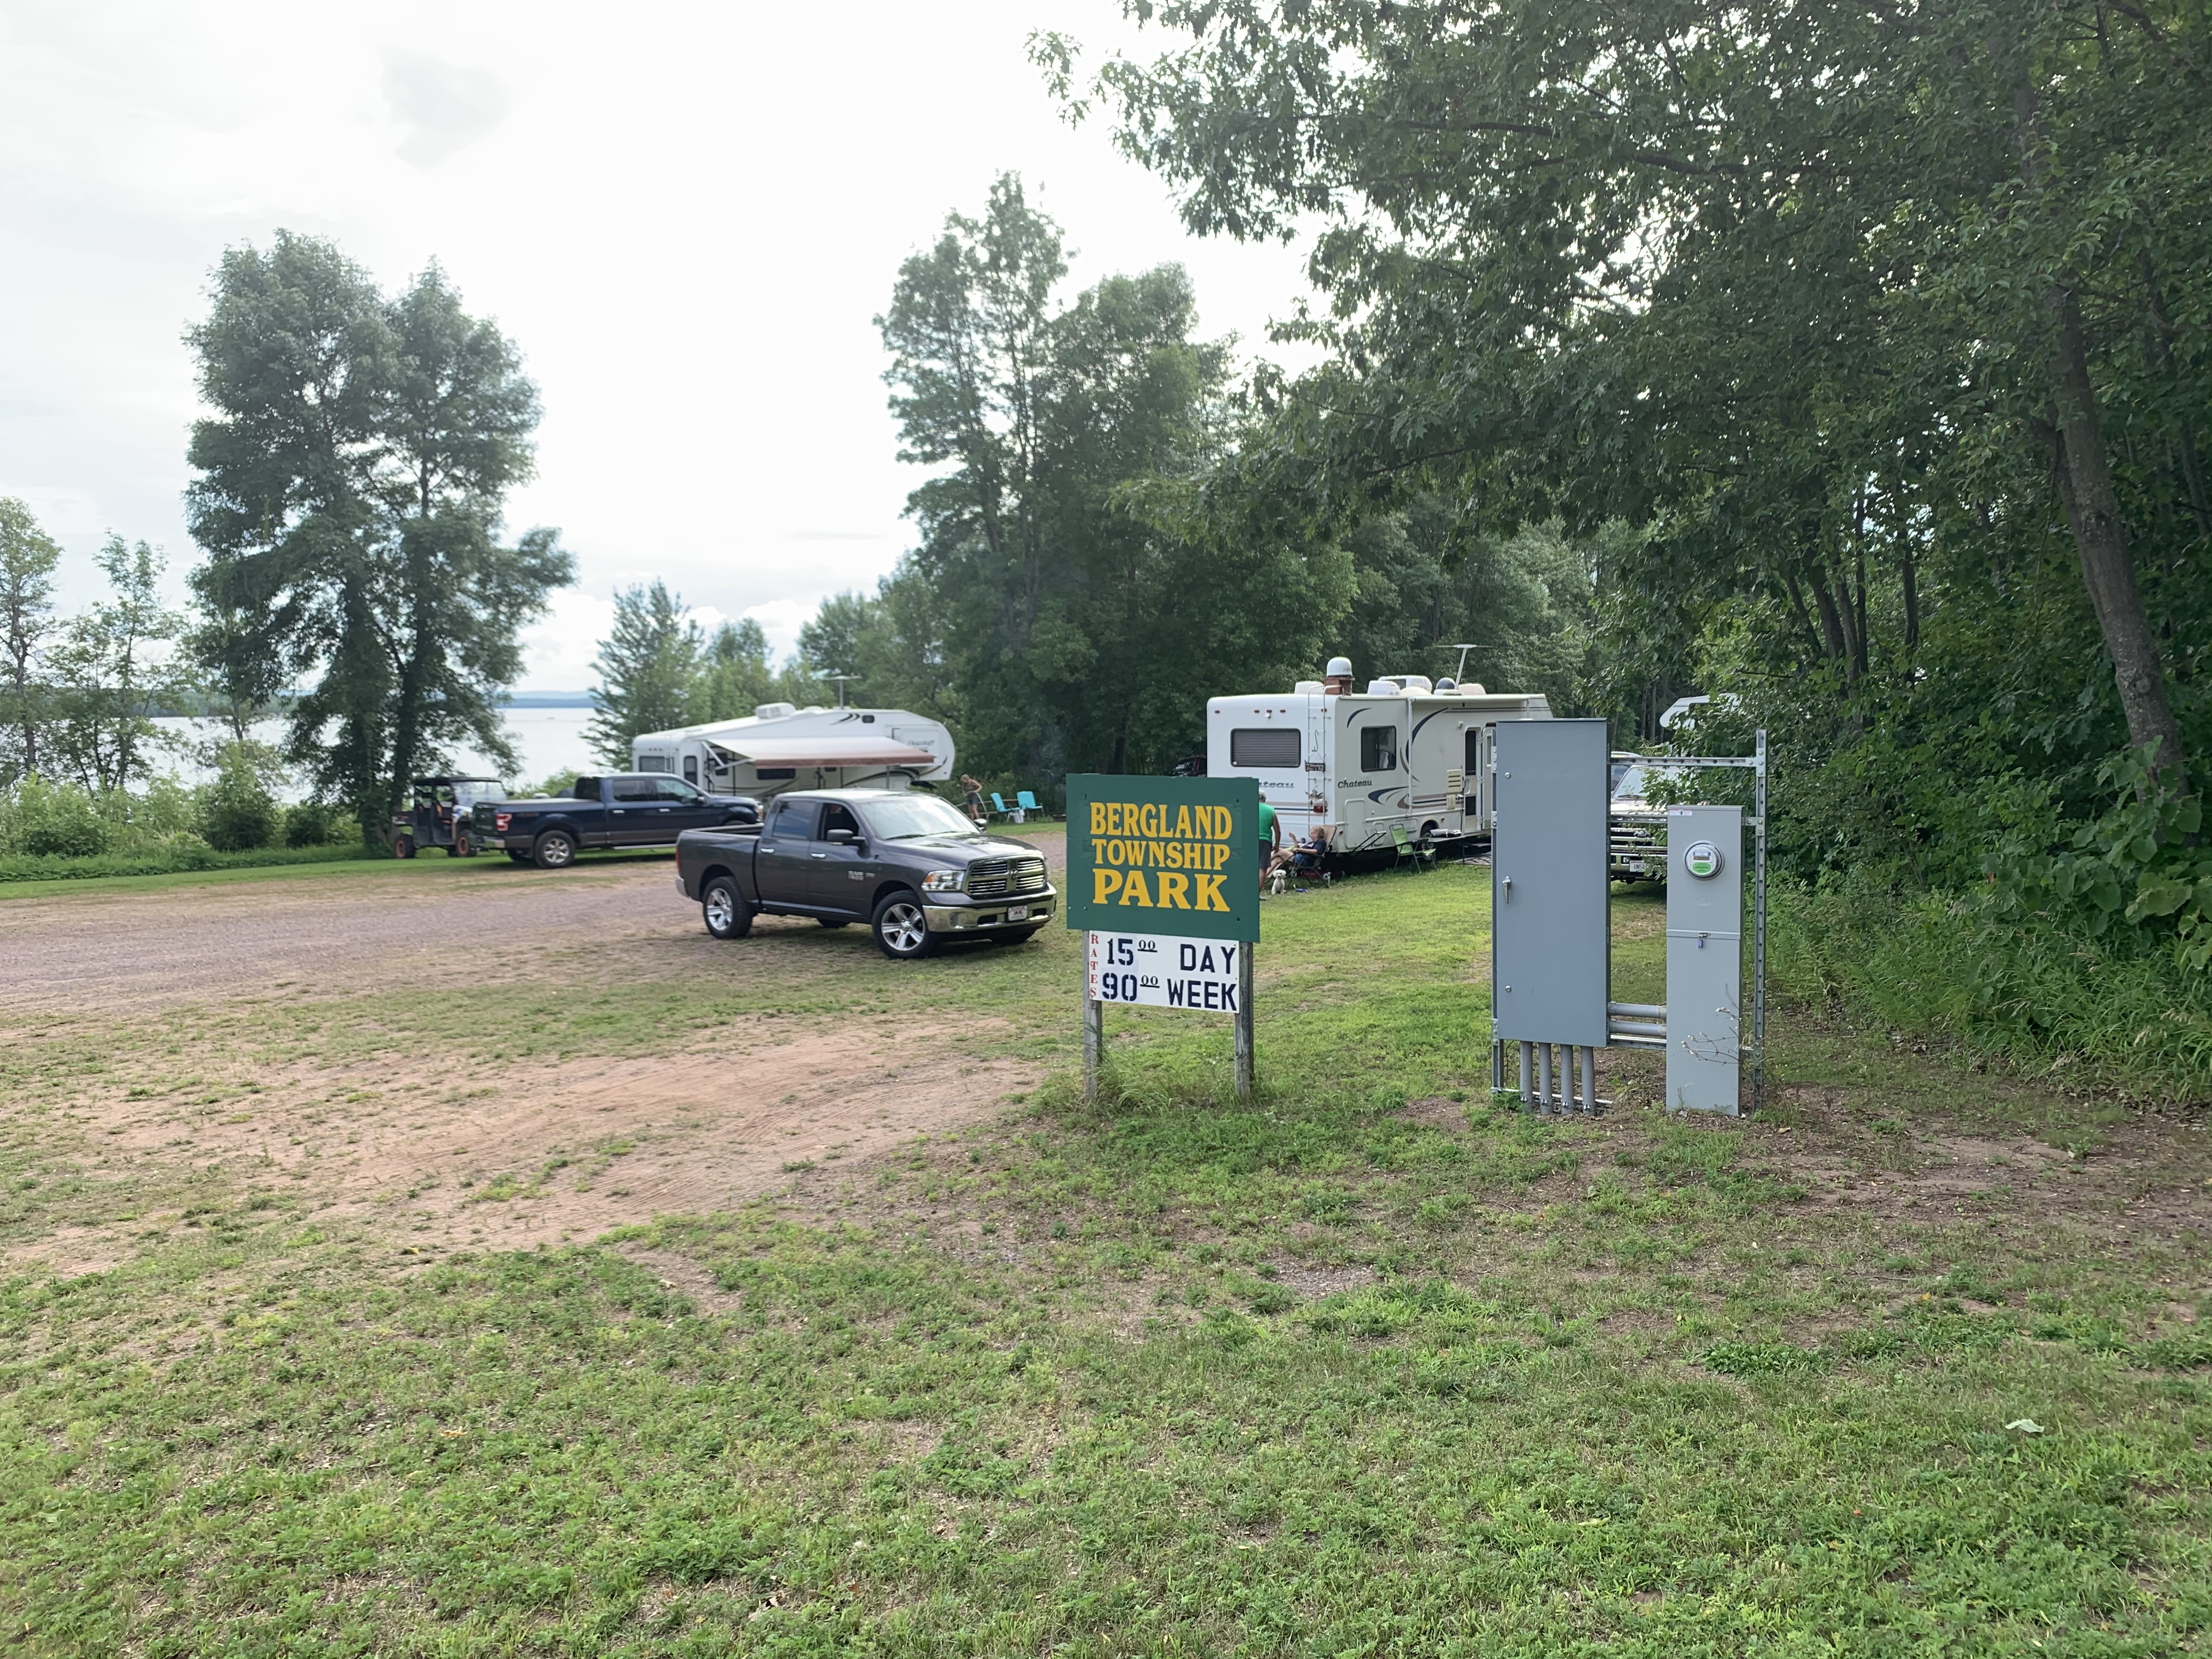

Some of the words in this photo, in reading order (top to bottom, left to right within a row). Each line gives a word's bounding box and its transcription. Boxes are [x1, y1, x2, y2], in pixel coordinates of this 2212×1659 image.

[1338, 780, 1372, 788] Chateau
[1090, 802, 1232, 839] BERGLAND
[1091, 839, 1230, 870] TOWNSHIP
[1092, 868, 1230, 912] PARK
[1090, 934, 1099, 997] RATES
[1180, 944, 1236, 974] DAY
[1167, 978, 1237, 1011] WEEK
